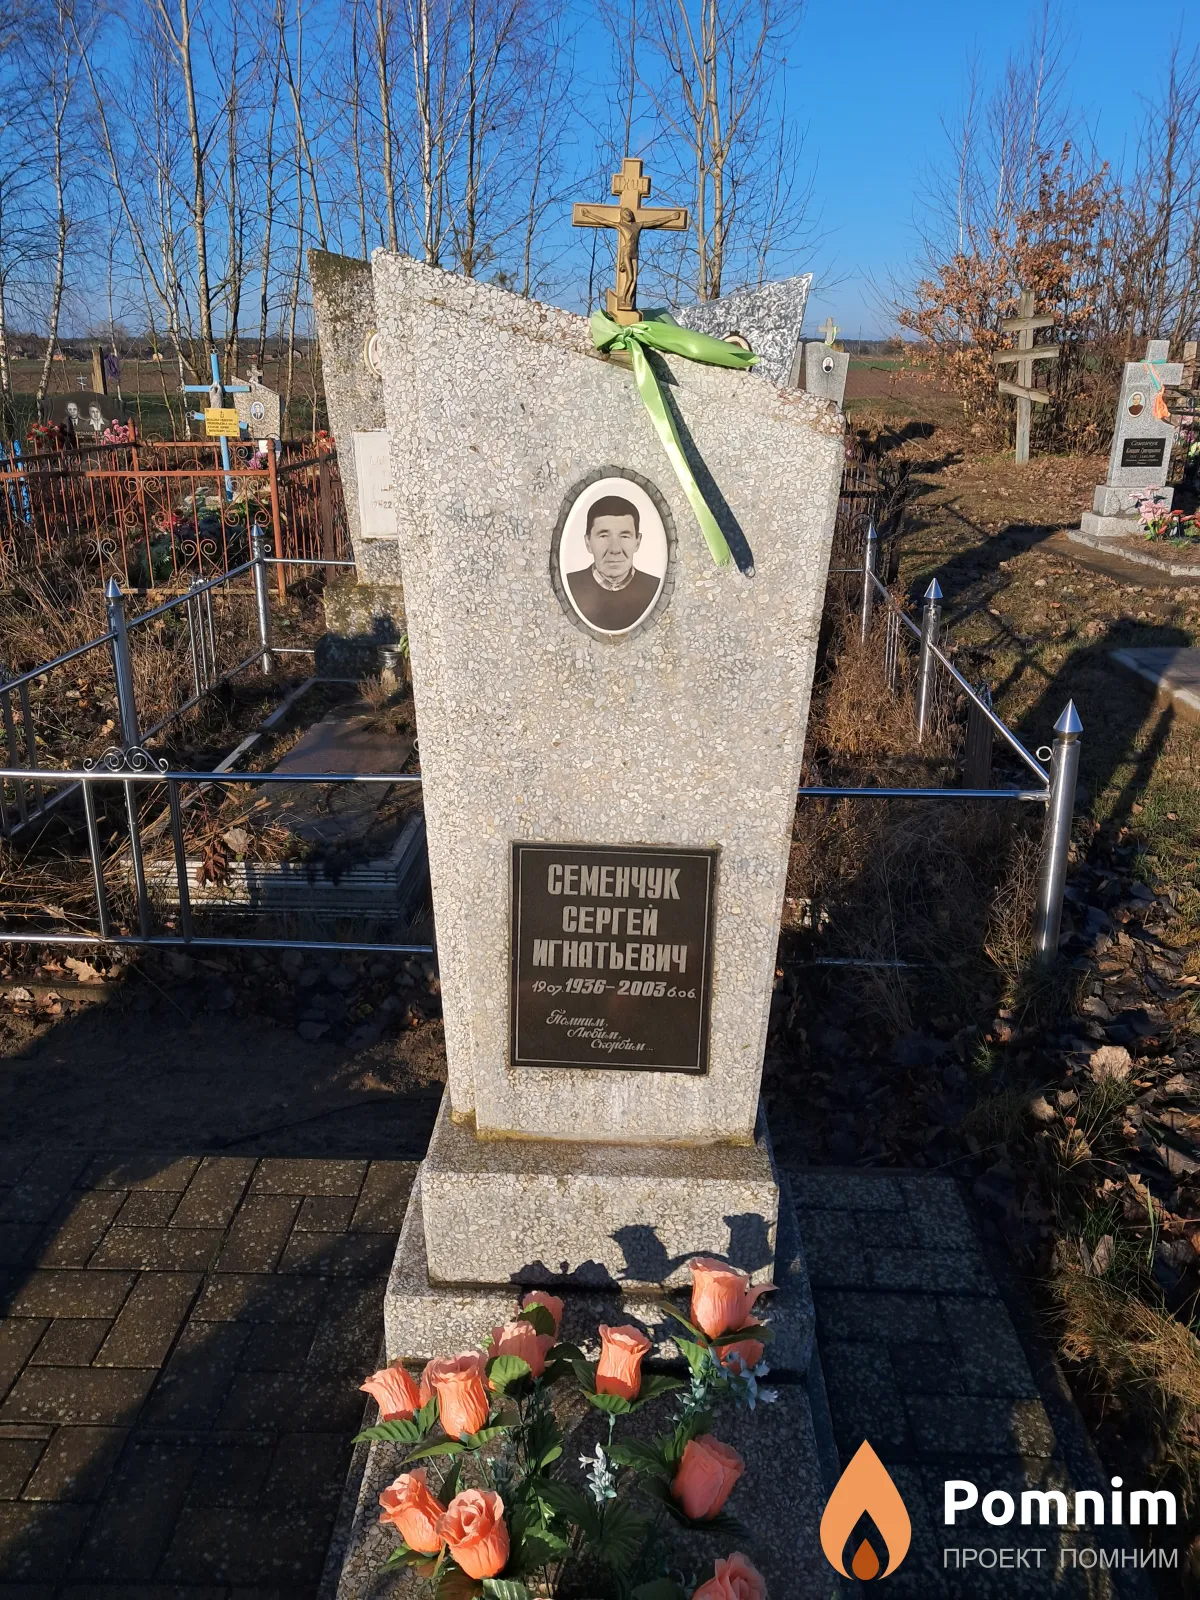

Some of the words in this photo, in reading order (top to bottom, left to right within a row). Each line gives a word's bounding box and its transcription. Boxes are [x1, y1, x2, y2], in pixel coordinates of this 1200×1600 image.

[547, 864, 681, 899] СЕМЕНЧУК
[562, 904, 659, 936] СЕРГЕЙ
[532, 939, 688, 973] ИГНАТЬЕВИЧ
